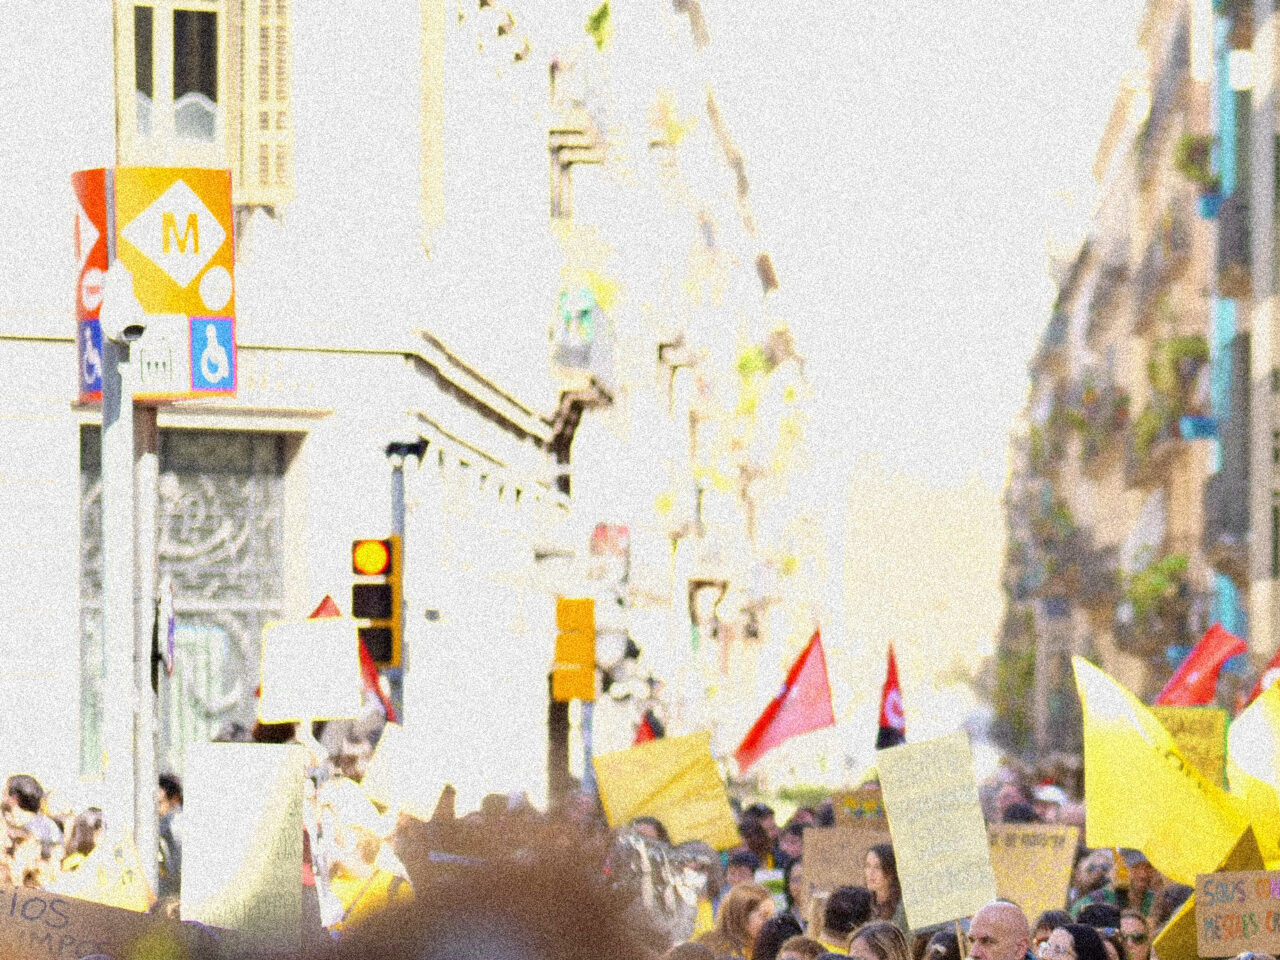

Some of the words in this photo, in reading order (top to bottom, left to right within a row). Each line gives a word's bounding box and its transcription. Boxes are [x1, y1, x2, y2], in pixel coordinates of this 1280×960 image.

[161, 211, 200, 255] M
[0, 886, 70, 930] IOS
[1203, 879, 1247, 907] SOUS
